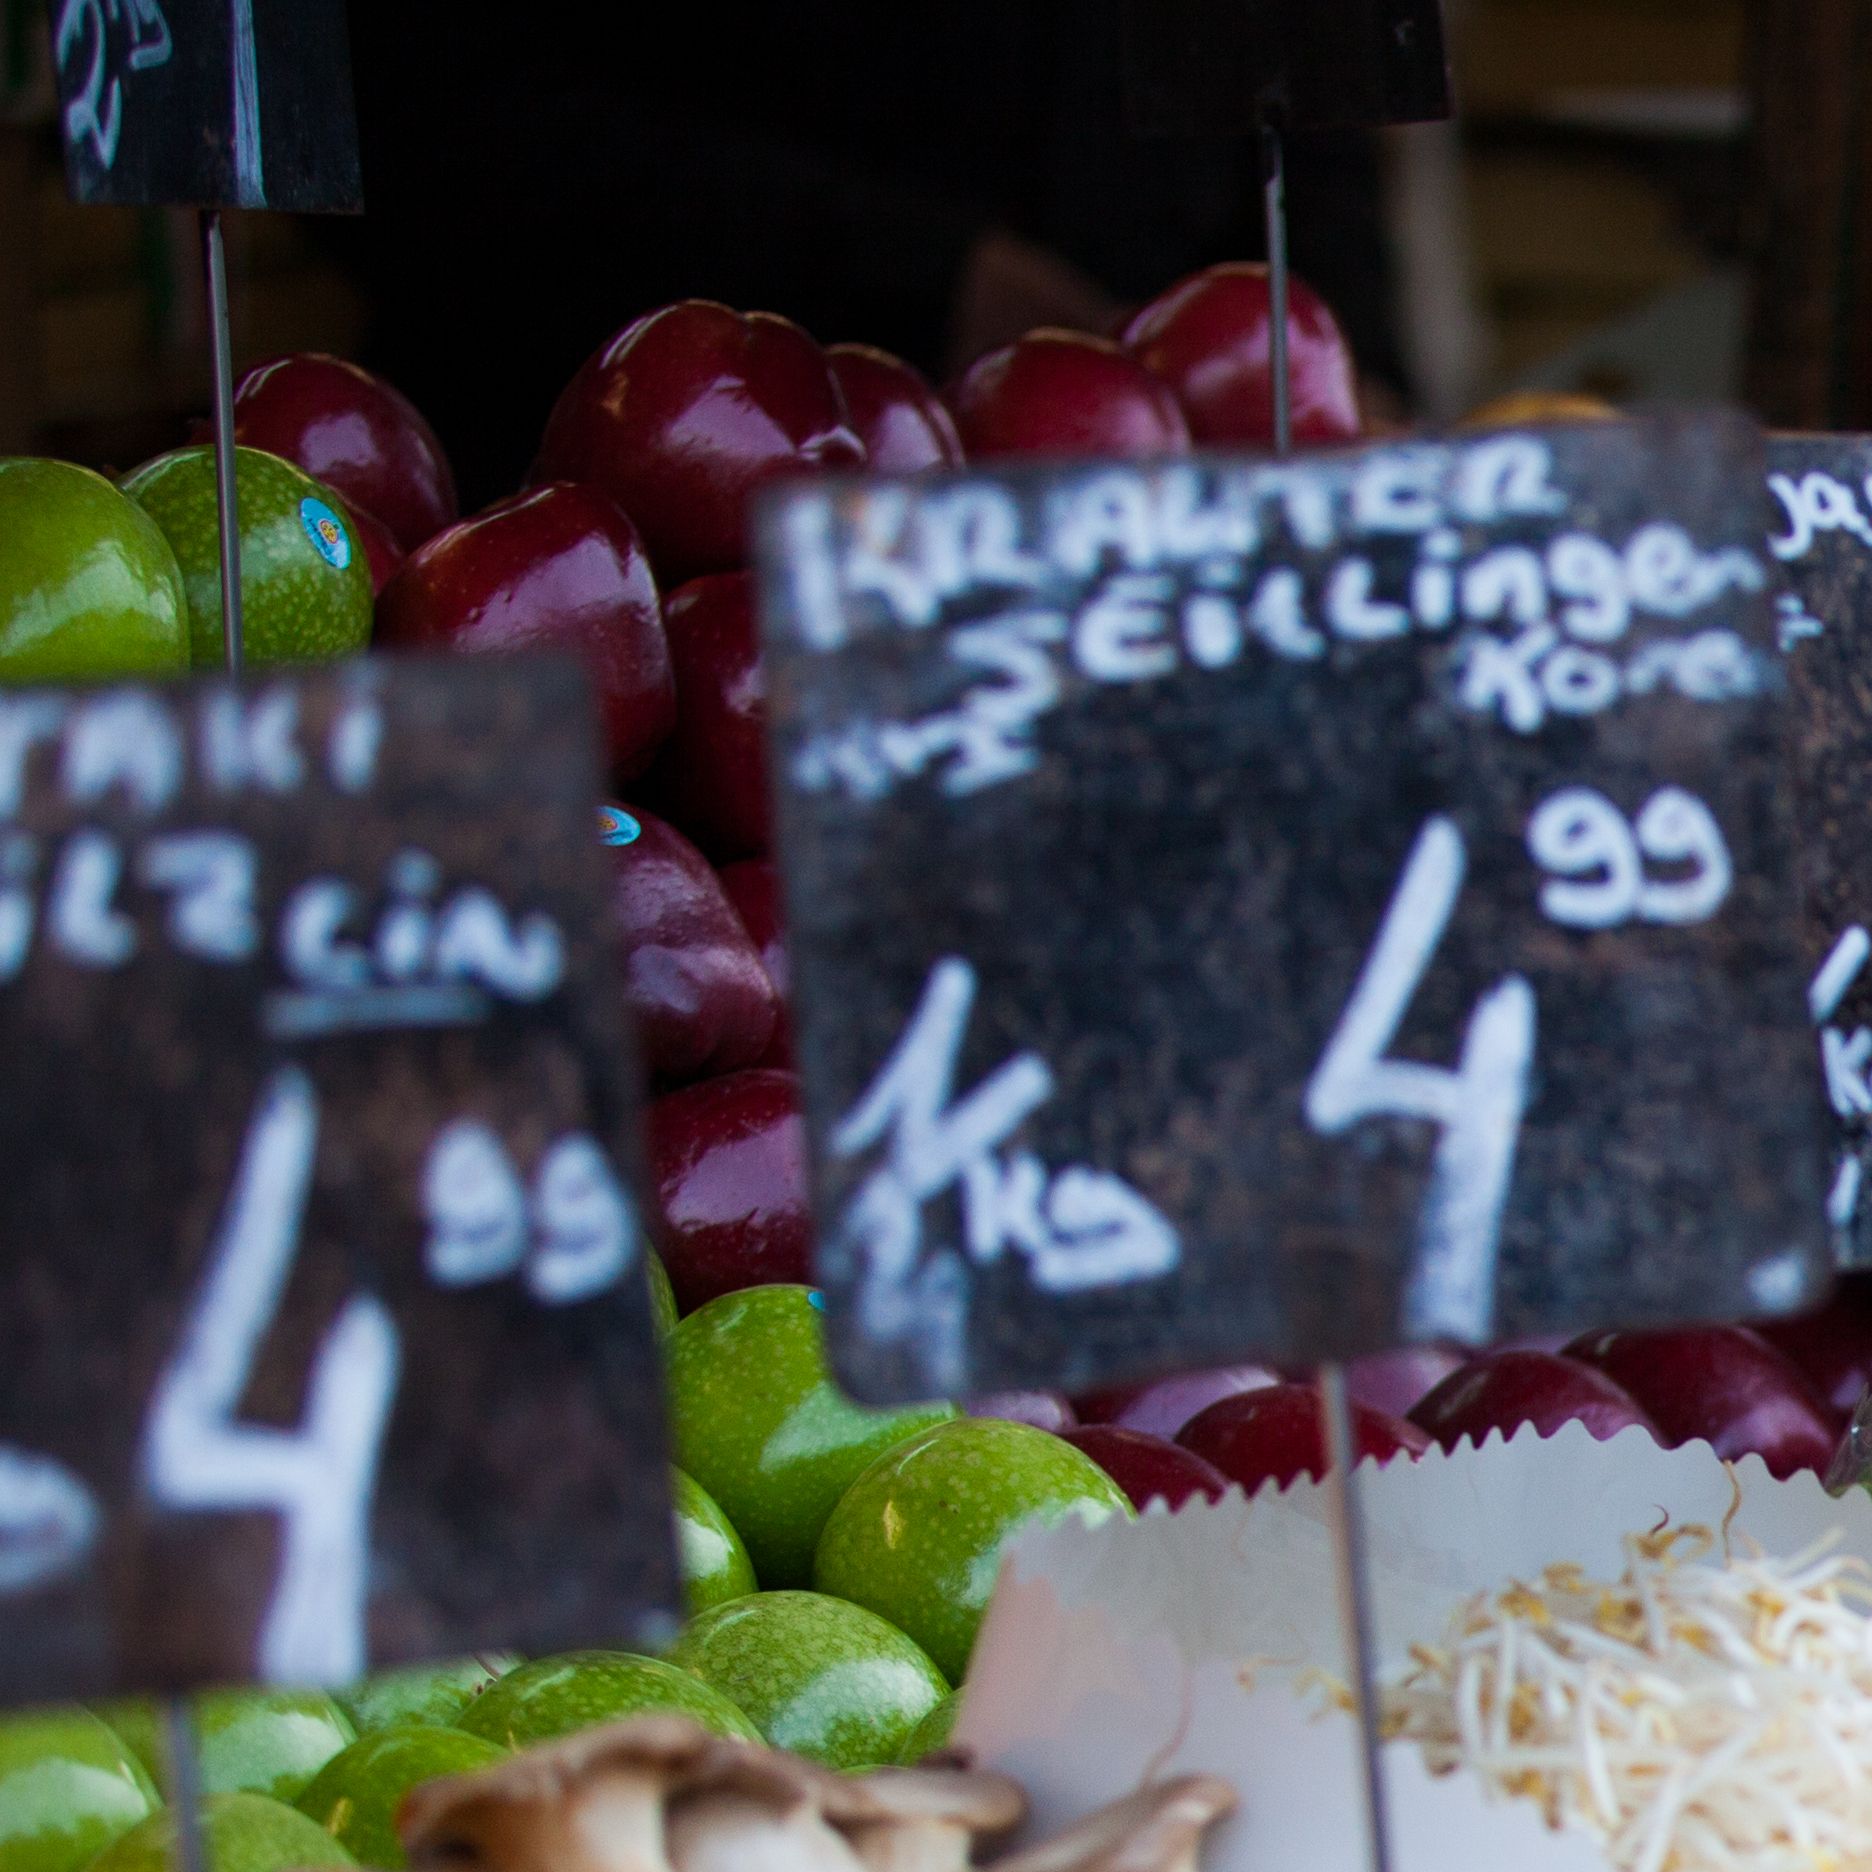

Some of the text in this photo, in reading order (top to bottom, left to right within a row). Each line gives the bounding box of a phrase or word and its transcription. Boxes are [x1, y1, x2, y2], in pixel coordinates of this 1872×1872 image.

[1304, 787, 1734, 1348] 4 99
[143, 1062, 400, 1690] 4
